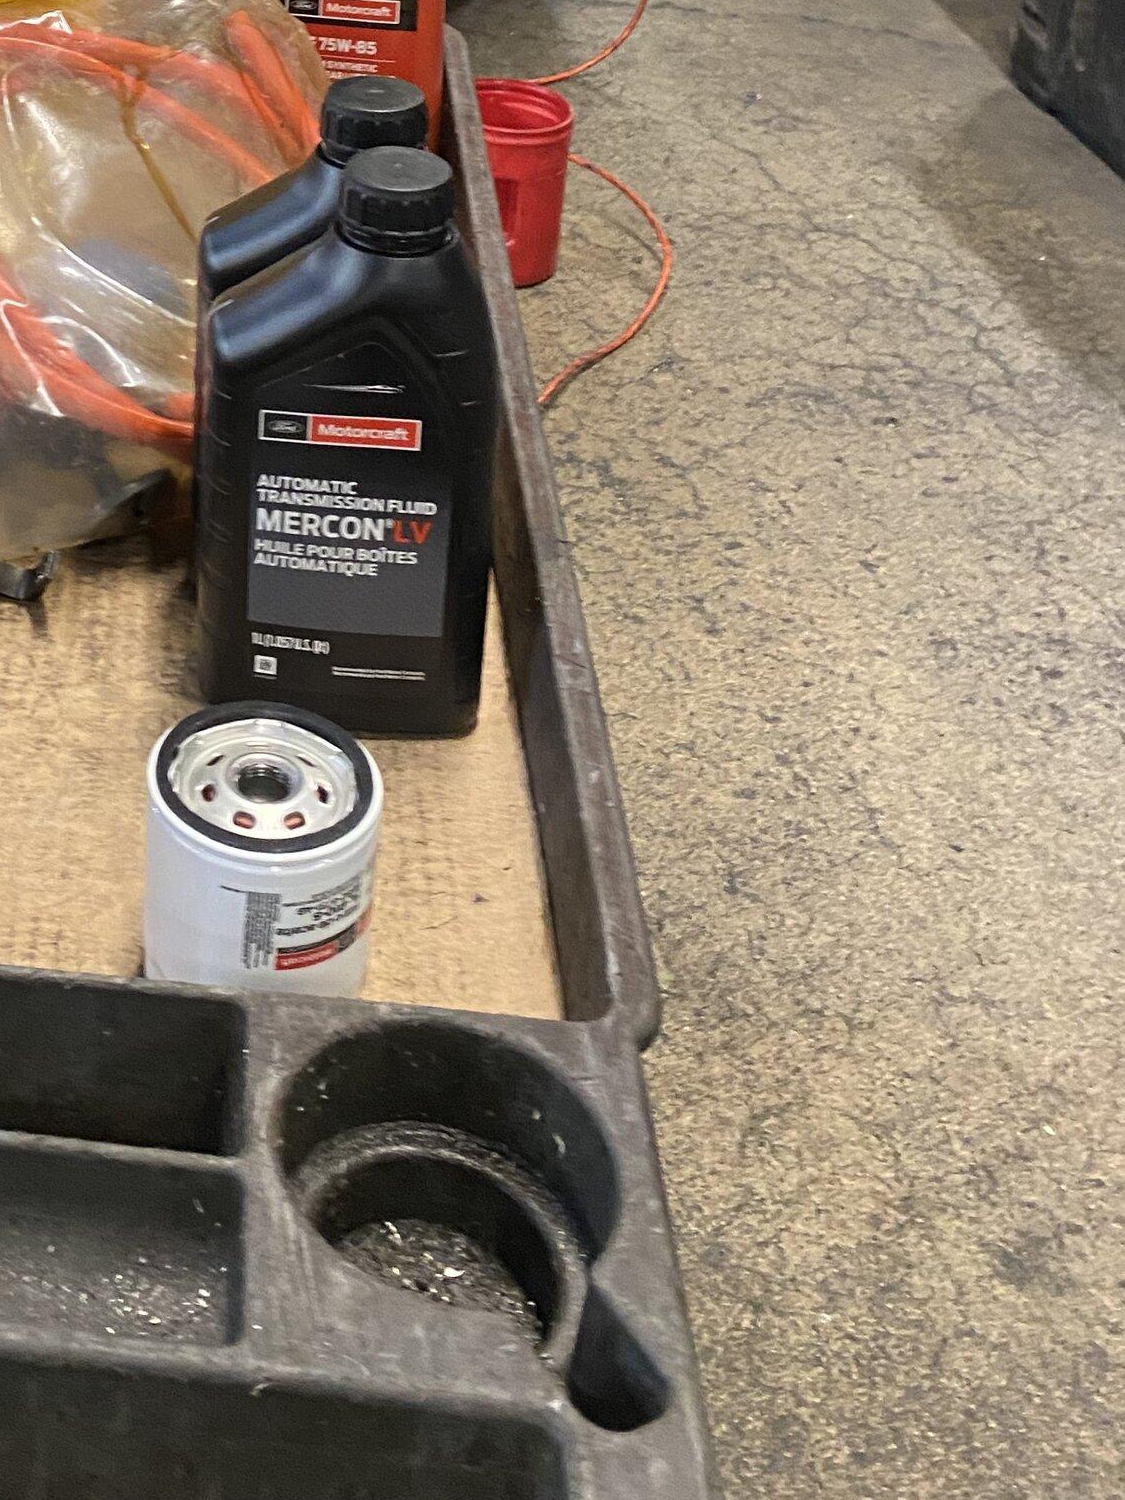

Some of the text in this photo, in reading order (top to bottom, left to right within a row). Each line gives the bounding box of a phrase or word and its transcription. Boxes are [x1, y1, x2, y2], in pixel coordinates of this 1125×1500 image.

[326, 2, 393, 17] Motorcraft
[318, 424, 409, 441] Motorcraft
[256, 474, 358, 495] AUTOMATIC
[256, 489, 438, 516] TRANSMISSION FLUID
[254, 538, 418, 565] HUILE POUR BOÎTES
[254, 553, 379, 577] AUTOMATIQUE
